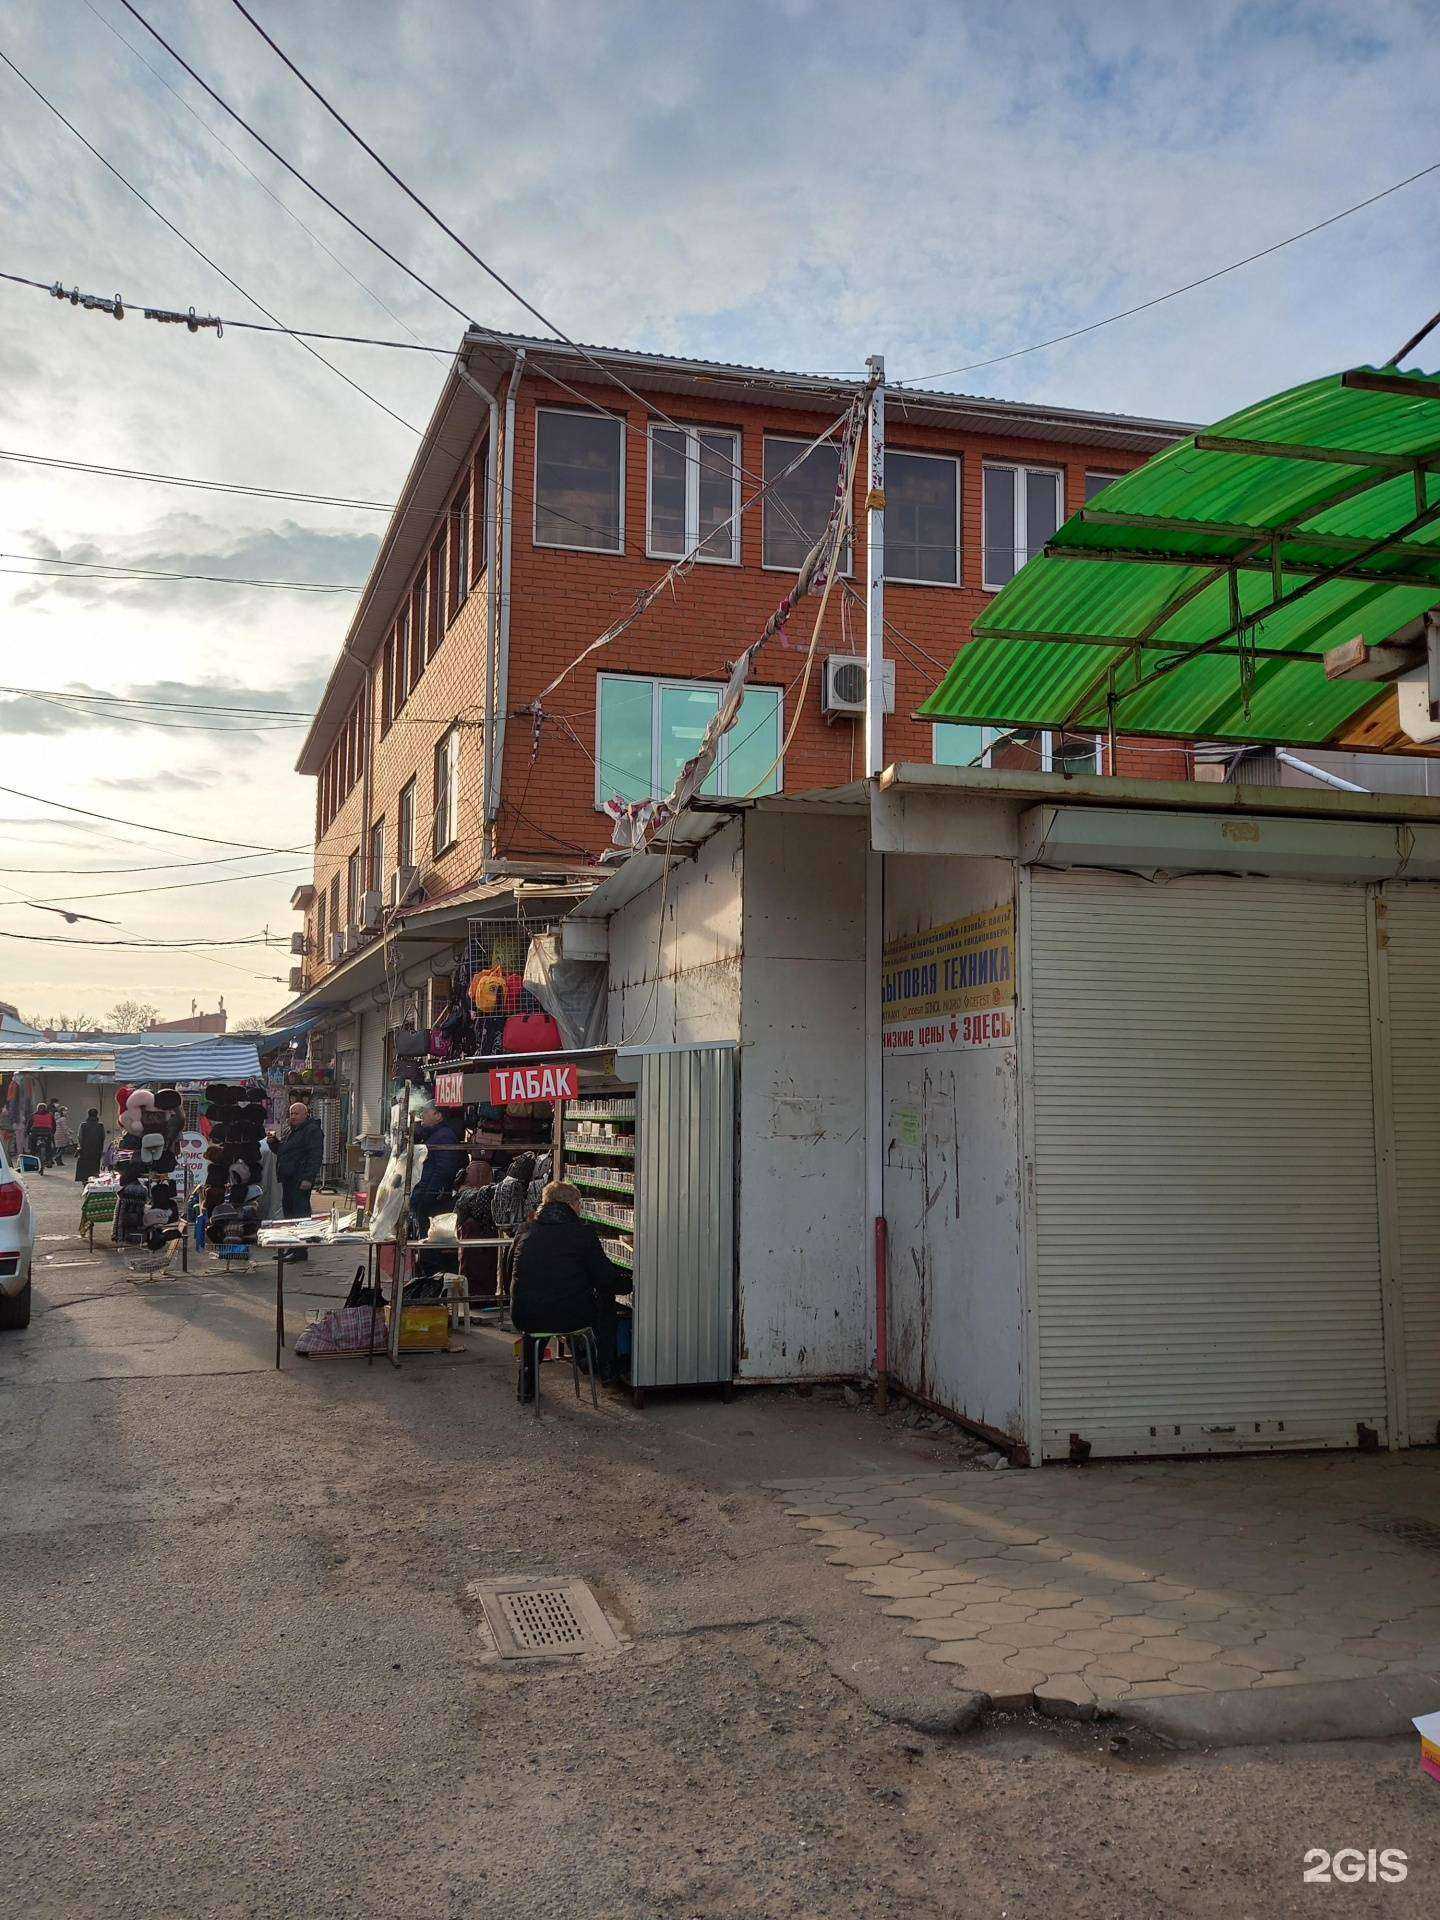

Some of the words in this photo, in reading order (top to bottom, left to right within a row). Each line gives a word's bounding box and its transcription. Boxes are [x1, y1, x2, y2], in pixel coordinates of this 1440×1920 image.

[944, 946, 1010, 991] ТЕХНИКА
[919, 1024, 945, 1047] цены
[963, 1011, 1011, 1045] ЗДЕСЬ
[436, 1076, 463, 1106] ТАБАК
[495, 1067, 572, 1101] ТАБАК
